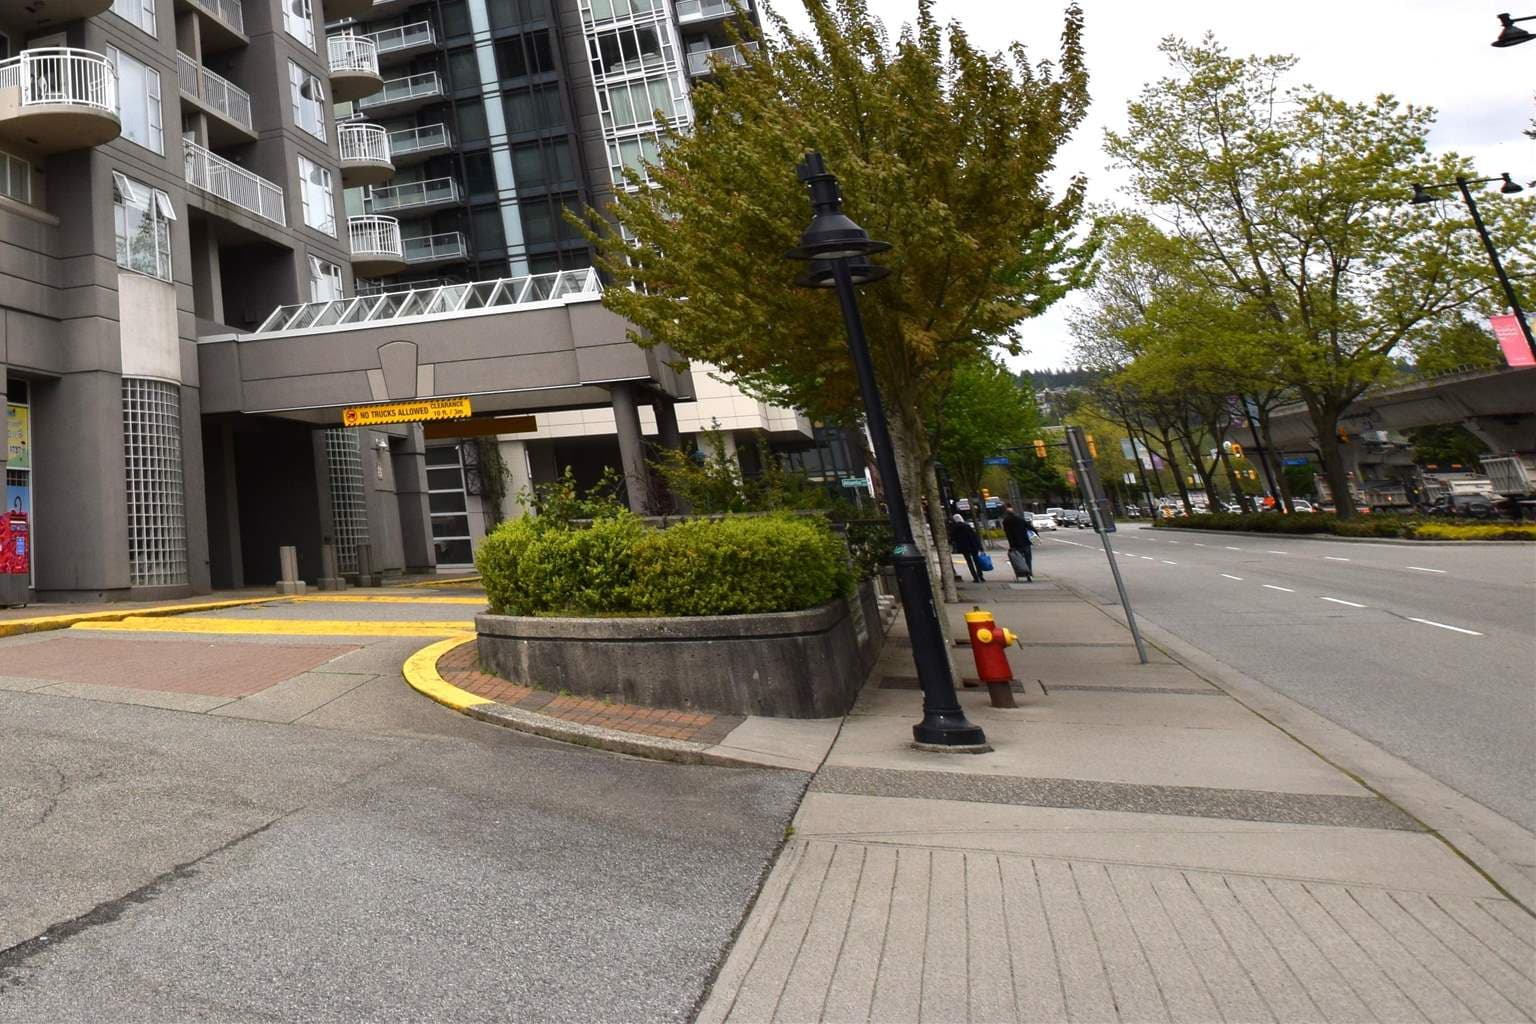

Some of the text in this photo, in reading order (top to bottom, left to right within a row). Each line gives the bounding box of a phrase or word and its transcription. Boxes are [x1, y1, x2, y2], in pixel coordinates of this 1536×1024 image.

[430, 400, 464, 410] CLEARANCE
[360, 407, 429, 420] NO TRUCKS ALLOWED
